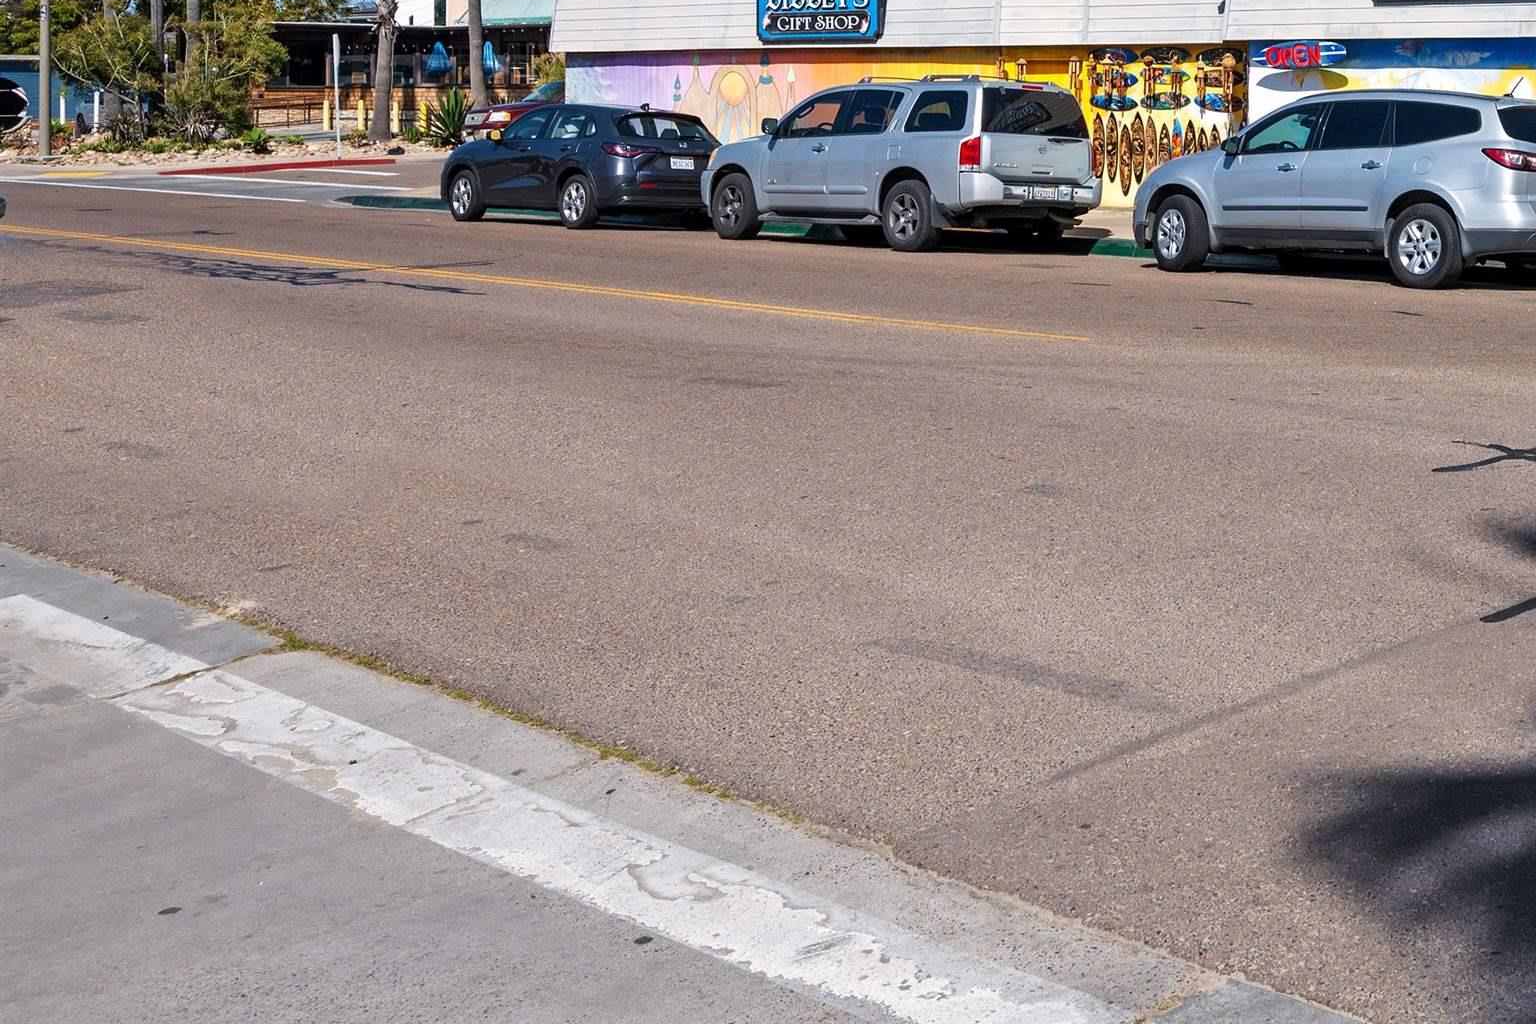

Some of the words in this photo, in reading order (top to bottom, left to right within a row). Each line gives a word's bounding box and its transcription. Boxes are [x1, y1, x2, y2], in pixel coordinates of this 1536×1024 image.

[777, 17, 812, 31] GIFT
[815, 16, 860, 31] SHOP
[1266, 44, 1320, 68] OPEN
